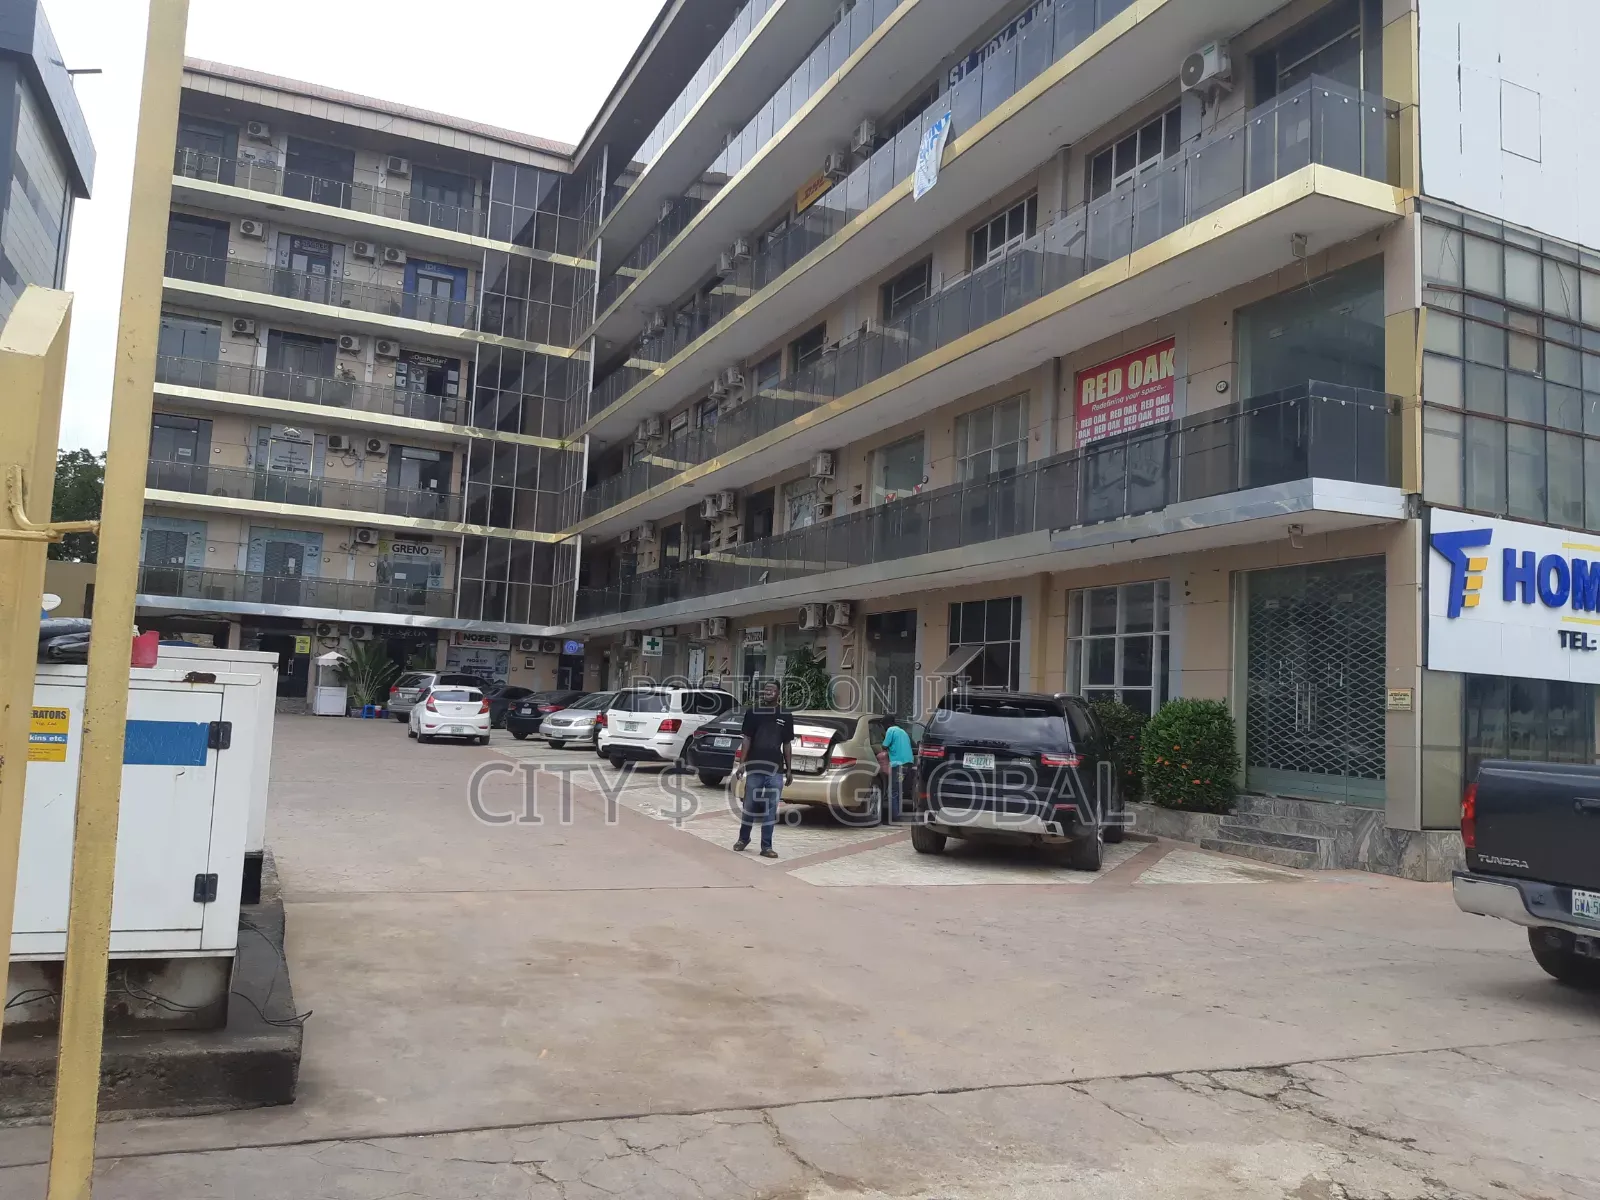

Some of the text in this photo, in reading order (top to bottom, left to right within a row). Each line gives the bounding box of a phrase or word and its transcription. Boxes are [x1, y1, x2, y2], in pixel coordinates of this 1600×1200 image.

[1082, 348, 1175, 405] RED OAK
[1080, 418, 1092, 429] RED
[1093, 414, 1106, 425] OAK
[1110, 409, 1122, 420] RED
[1123, 405, 1137, 416] OAK
[1140, 400, 1154, 411] RED
[1155, 394, 1171, 406] OAK
[1092, 397, 1124, 412] Redefining
[1125, 391, 1140, 402] your
[1078, 408, 1169, 439] OAK RED OAK RED OAK RED
[392, 544, 429, 556] GRENO
[463, 633, 498, 643] NOZEC
[1558, 629, 1598, 651] TEL:
[1478, 854, 1529, 869] TUNDRA
